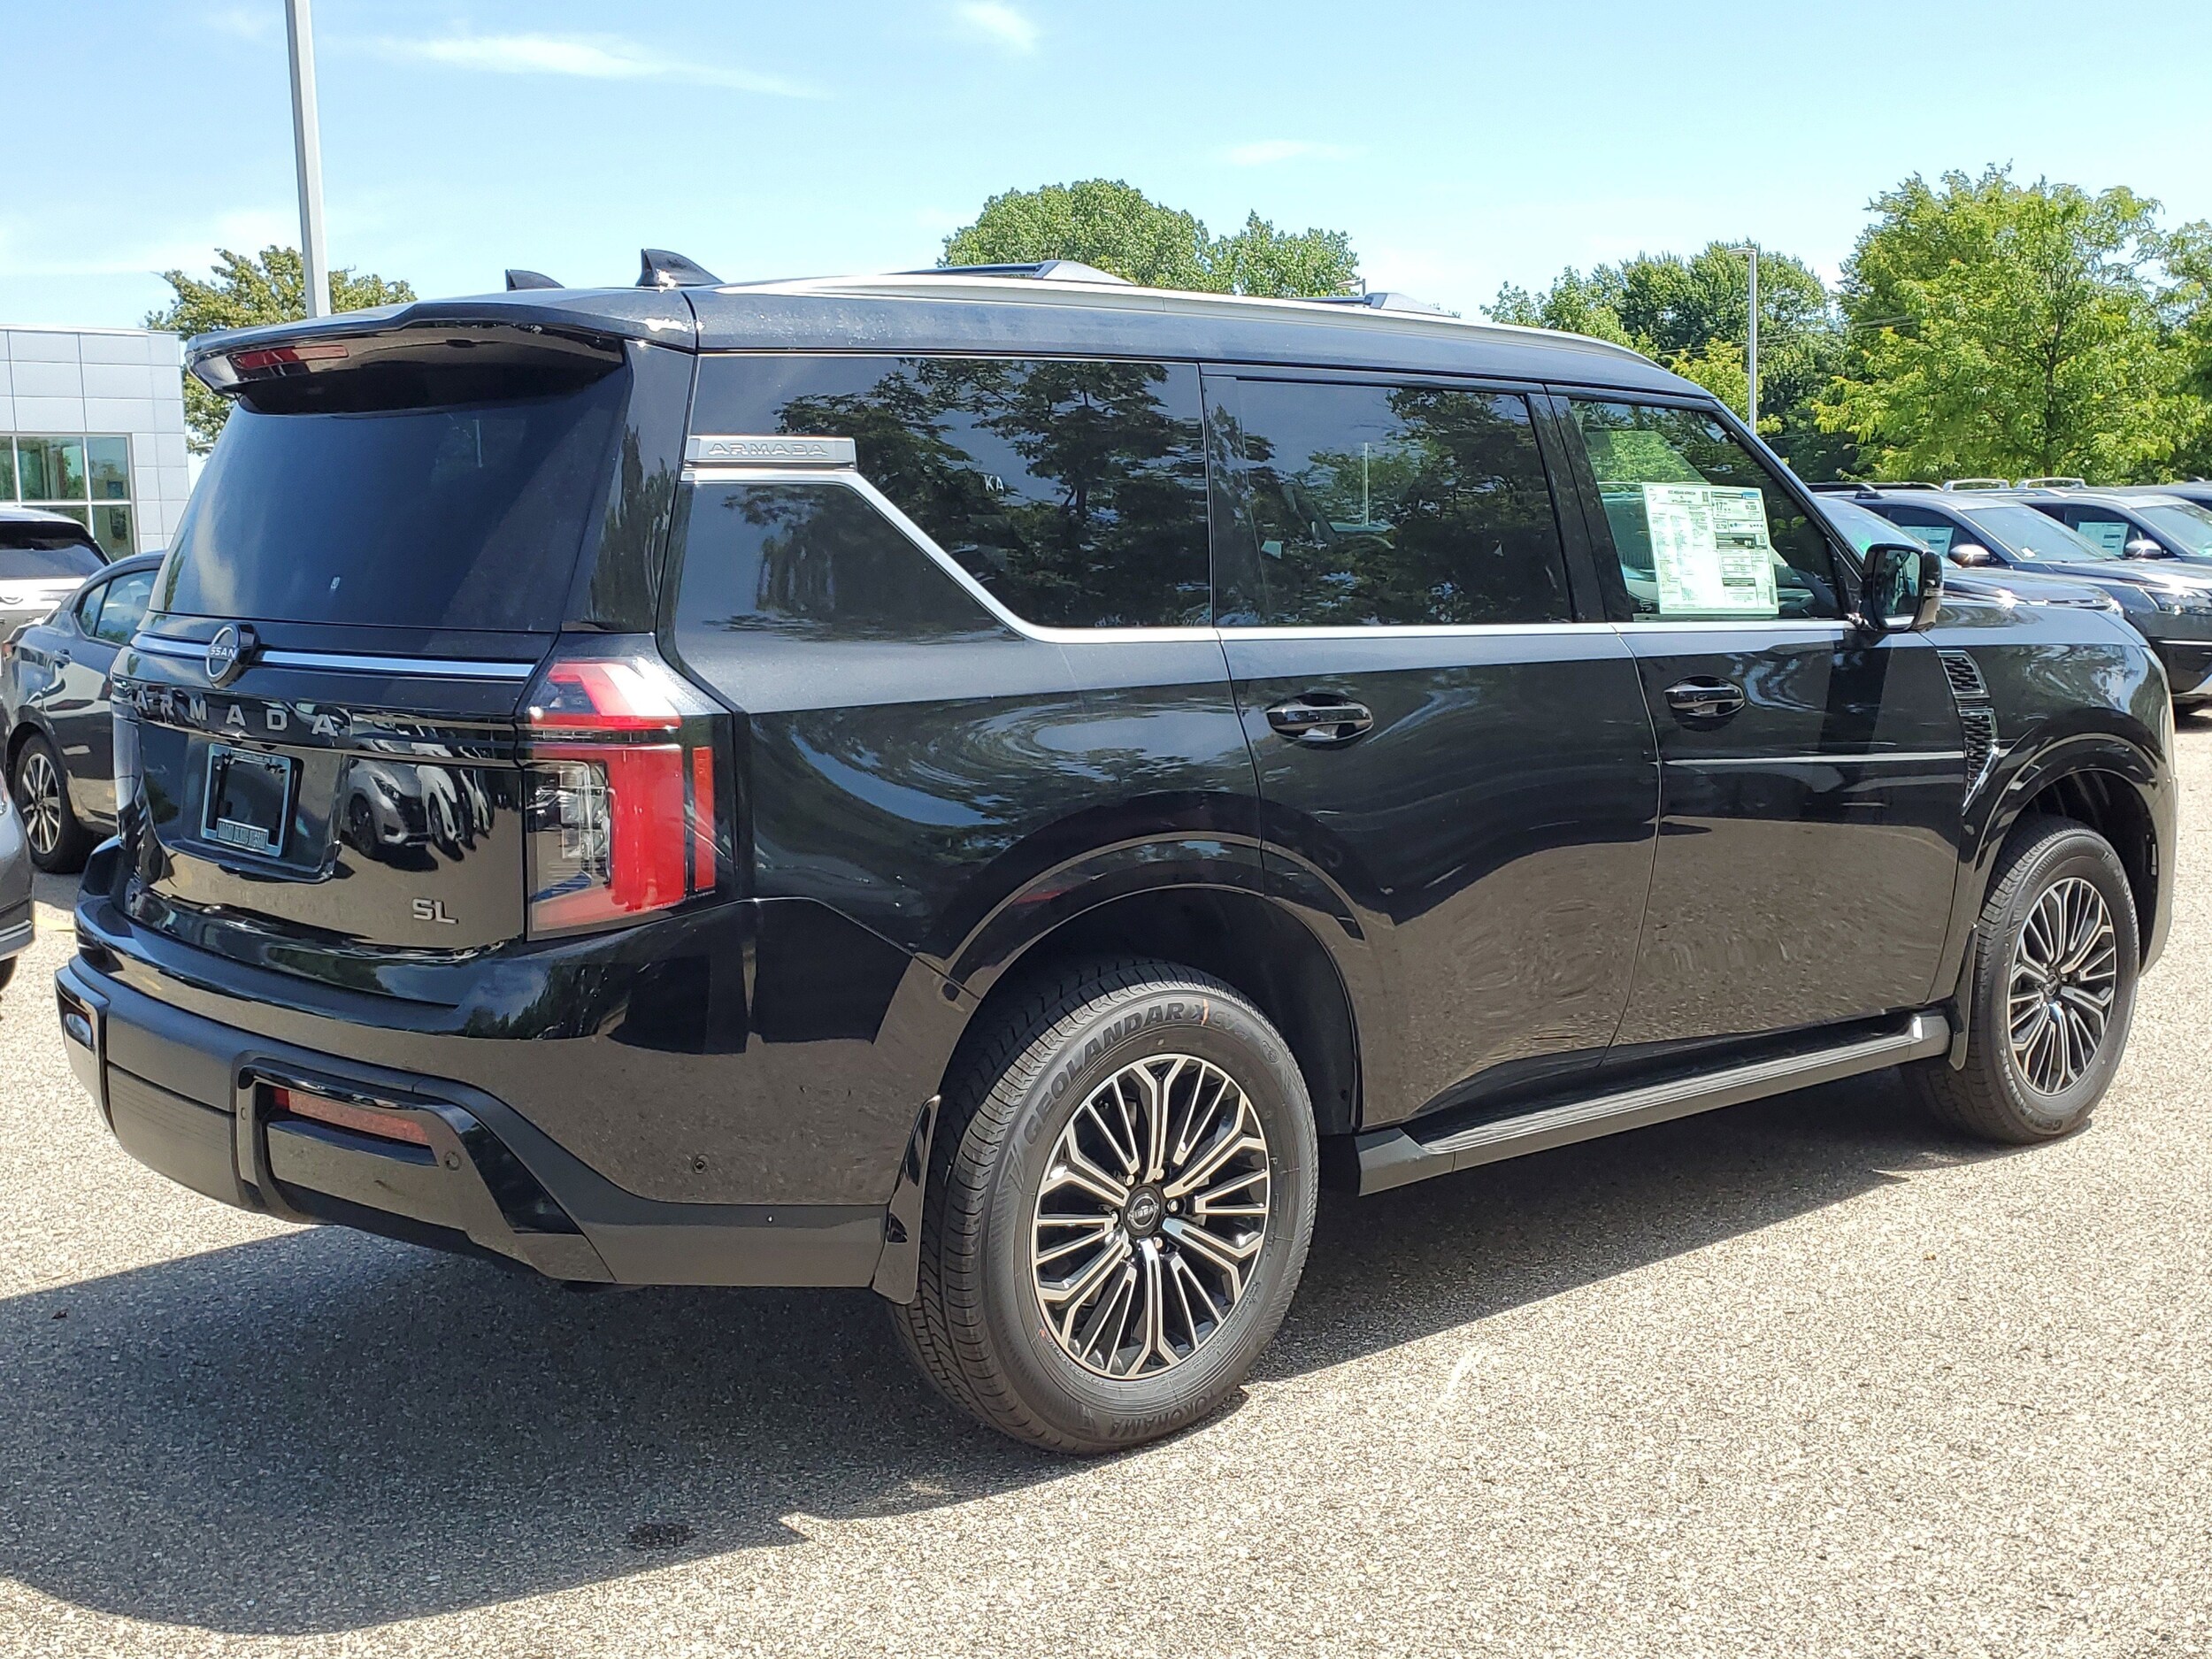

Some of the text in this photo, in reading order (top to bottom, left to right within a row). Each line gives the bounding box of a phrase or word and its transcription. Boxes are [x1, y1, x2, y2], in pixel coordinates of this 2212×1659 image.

[708, 442, 829, 456] ARMADA
[135, 689, 339, 737] ARMADA
[412, 898, 458, 925] SL
[1024, 1002, 1185, 1145] GEOLANDAR
